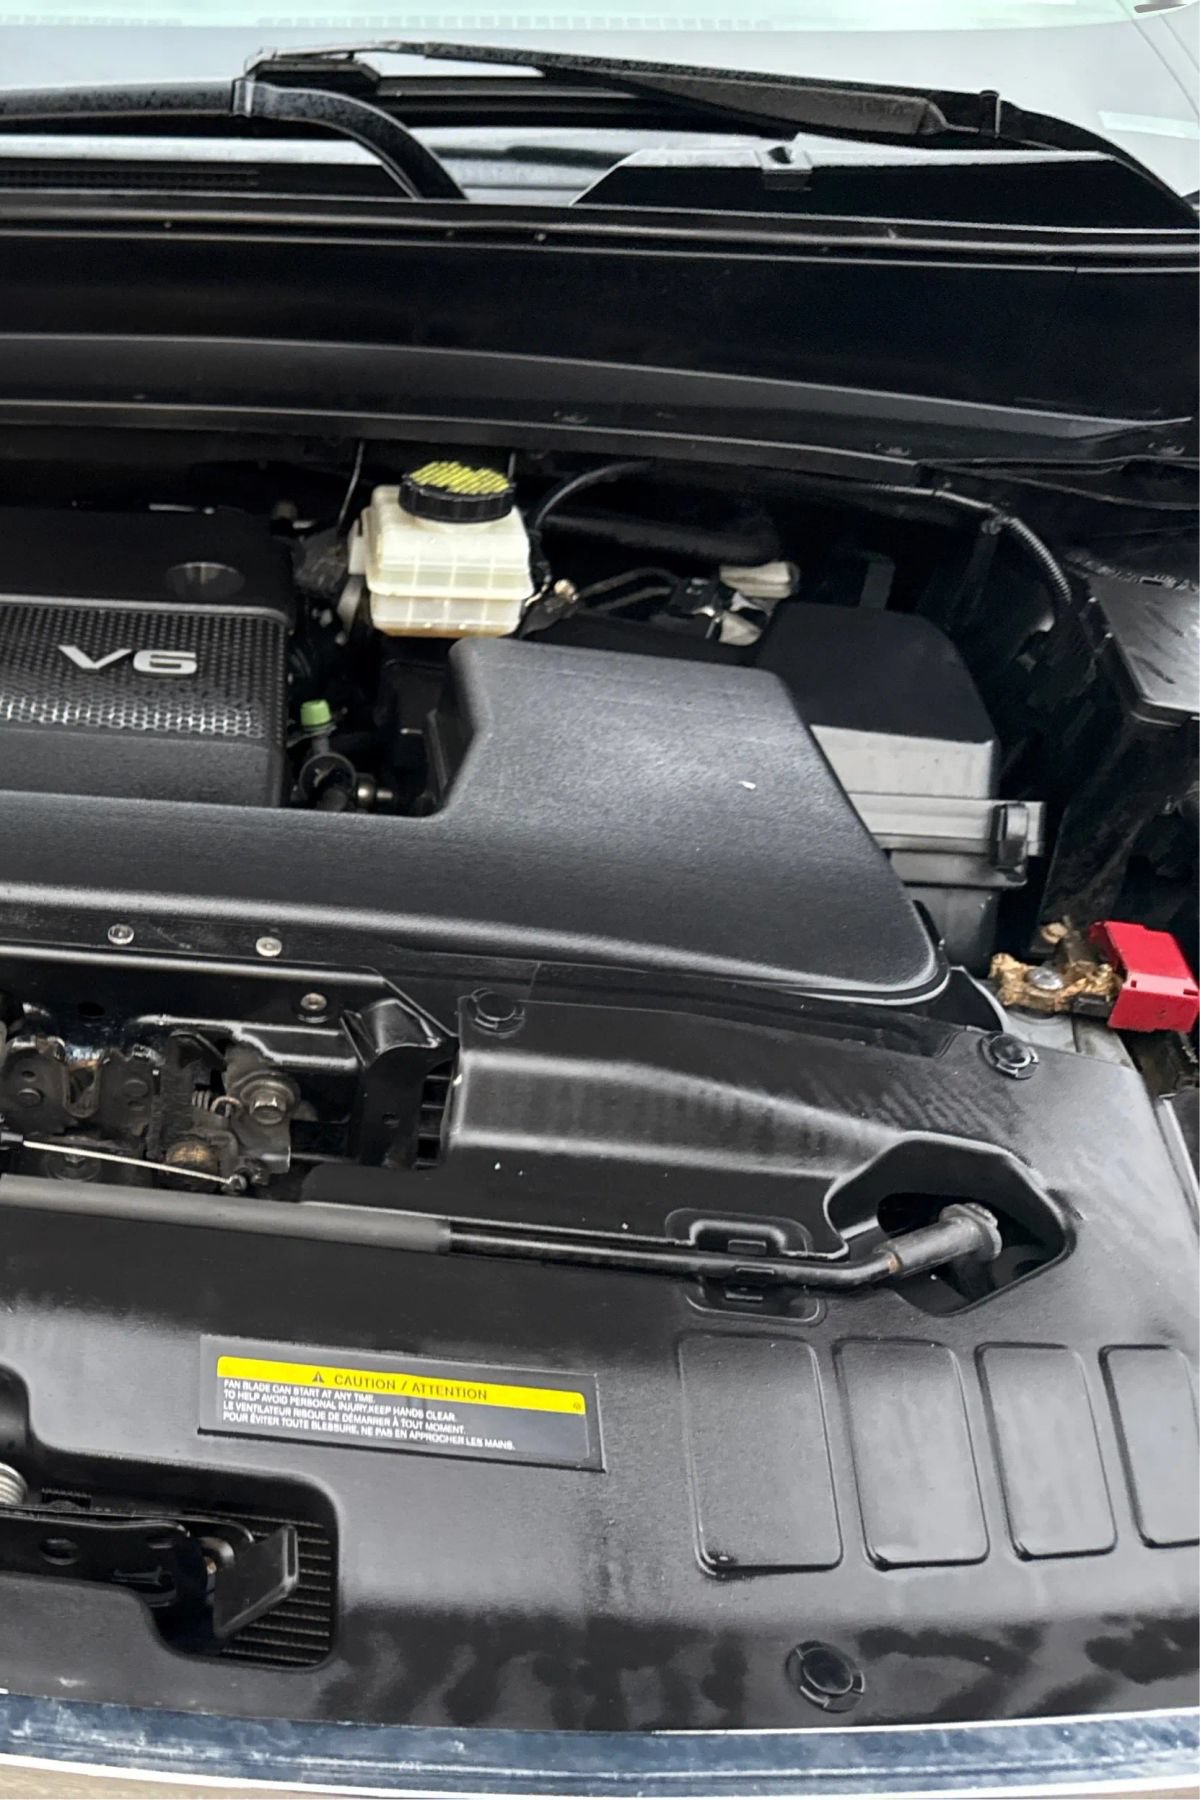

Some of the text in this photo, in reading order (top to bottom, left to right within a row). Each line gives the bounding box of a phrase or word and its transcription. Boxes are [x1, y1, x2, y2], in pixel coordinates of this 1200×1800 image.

[58, 645, 197, 674] V6
[224, 1378, 239, 1388] FAN
[243, 1380, 269, 1392] BLADE
[272, 1384, 290, 1394] CAN
[293, 1386, 319, 1397] START
[321, 1389, 332, 1398] AT
[334, 1390, 351, 1400] ANY
[334, 1375, 395, 1390] CAUTION
[412, 1383, 487, 1400] ATTENTION
[224, 1389, 234, 1398] TO
[238, 1391, 259, 1401] HELP
[261, 1393, 287, 1404] AVOID
[290, 1396, 336, 1409] PERSONAL
[393, 1406, 423, 1418] HANDS
[426, 1410, 455, 1421] CLEAR.
[224, 1400, 233, 1409] LE
[236, 1401, 290, 1415] VENTILATEUR
[293, 1408, 325, 1419] RISQUE
[328, 1411, 339, 1421] DE
[342, 1412, 390, 1426] DÉMARRER
[400, 1418, 422, 1429] TOUT
[425, 1421, 465, 1434] MOMENT.
[223, 1411, 247, 1422] POUR
[250, 1413, 279, 1425] ÉVITER
[281, 1417, 308, 1428] TOUTE
[361, 1425, 372, 1435] NE
[375, 1427, 392, 1437] PAS
[394, 1429, 406, 1438] EN
[409, 1430, 463, 1444] APPROCHER
[466, 1436, 482, 1446] LES
